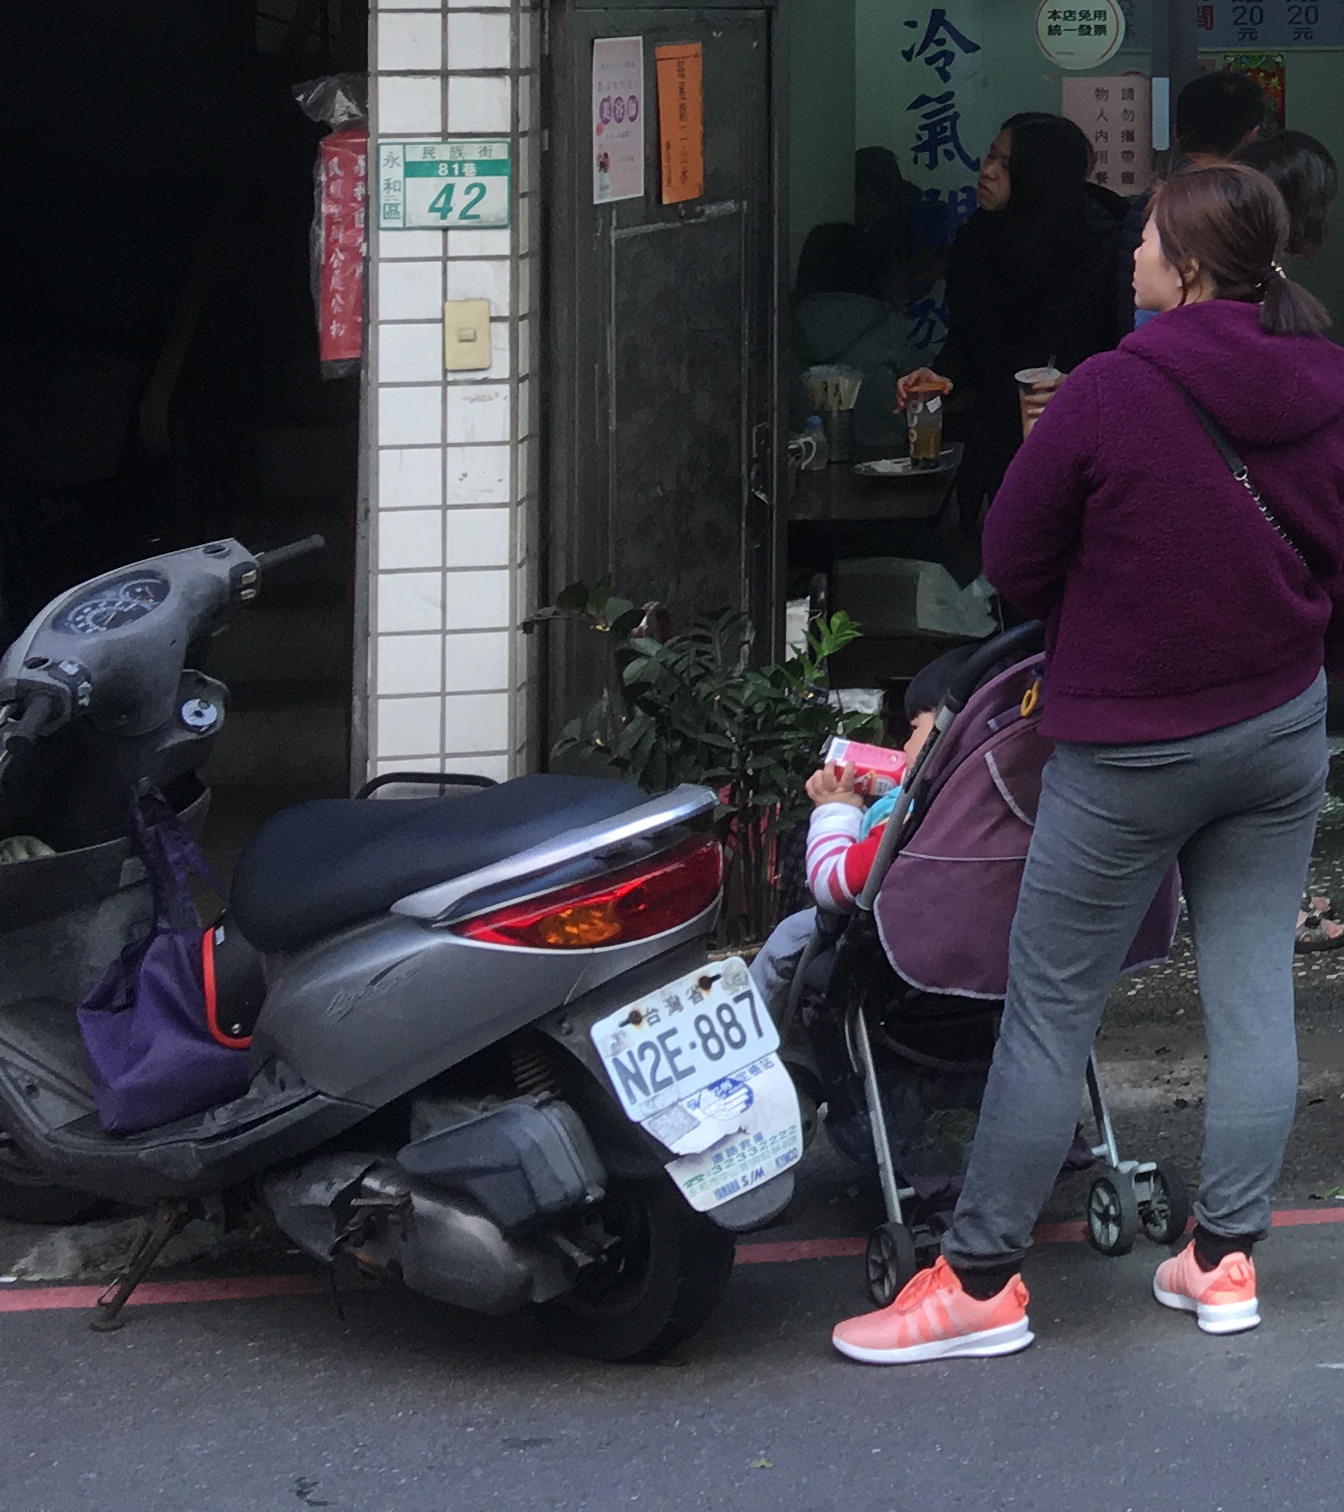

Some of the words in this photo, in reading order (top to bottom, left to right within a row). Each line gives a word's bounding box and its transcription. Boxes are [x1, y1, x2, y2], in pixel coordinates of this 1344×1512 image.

[1047, 9, 1107, 22] 本店免用
[1047, 24, 1108, 37] 統一發票
[421, 146, 493, 159] 民族街
[438, 162, 477, 176] 81巷
[382, 151, 402, 220] 永和區
[428, 182, 487, 221] 42
